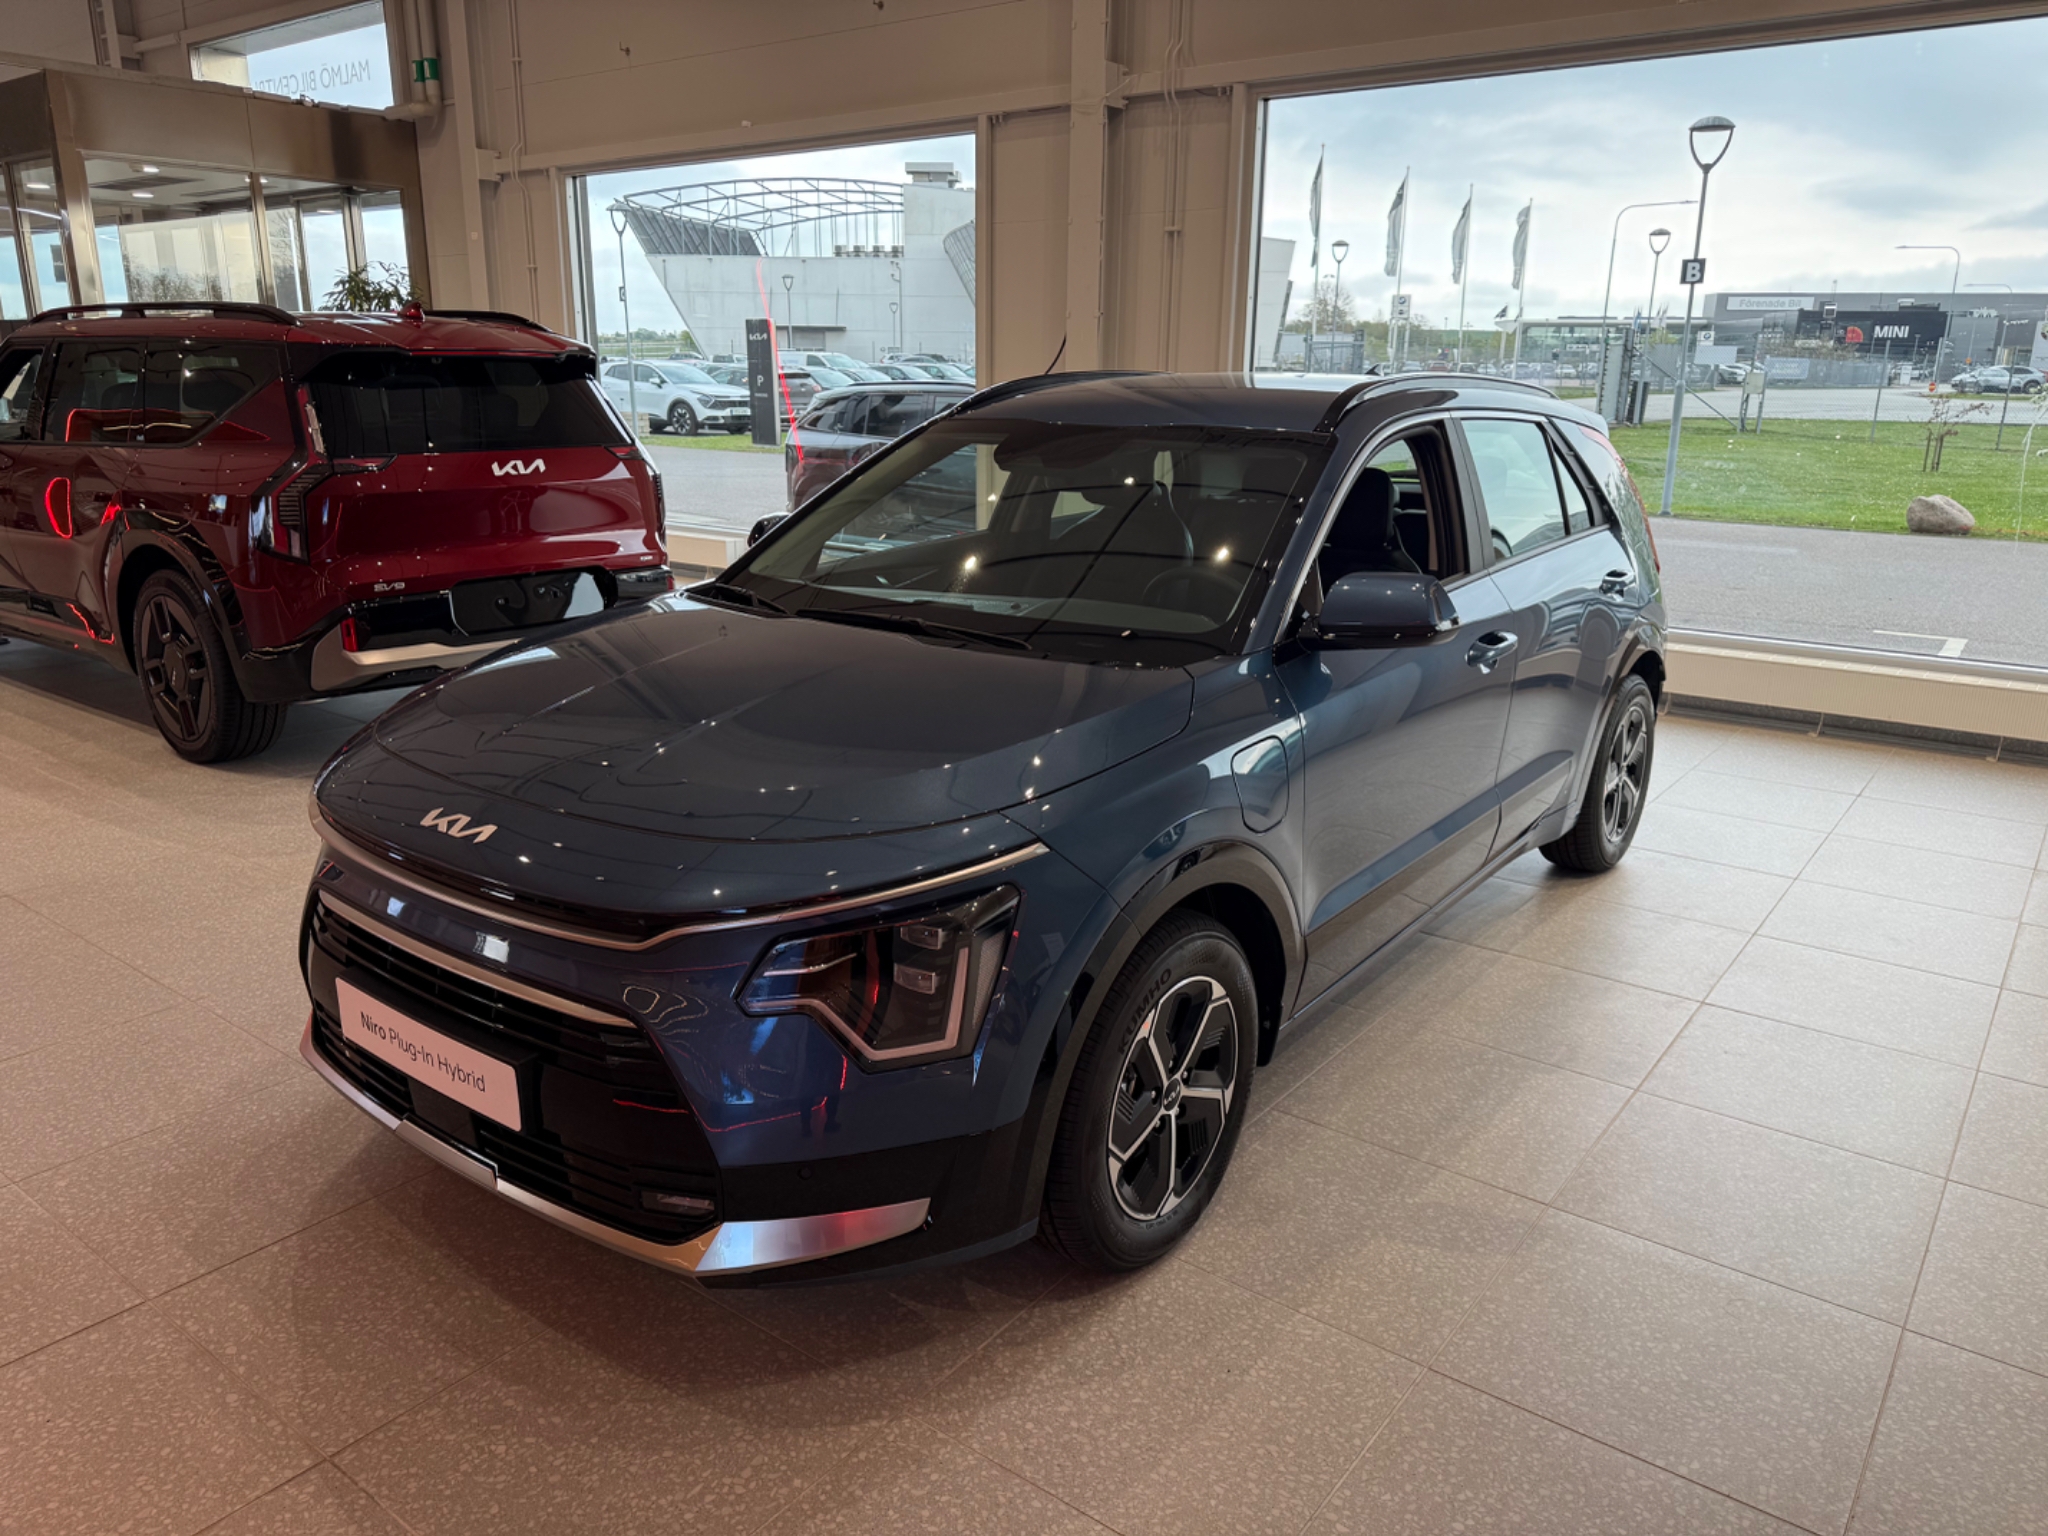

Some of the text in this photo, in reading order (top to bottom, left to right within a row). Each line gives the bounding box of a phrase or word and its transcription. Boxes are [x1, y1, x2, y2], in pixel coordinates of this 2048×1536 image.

[1685, 261, 1701, 282] B
[1873, 325, 1910, 338] MINI
[757, 375, 764, 386] P
[491, 458, 546, 477] KIA
[373, 581, 405, 592] EV9
[420, 807, 498, 843] KIA
[1117, 968, 1172, 1055] KUMHO
[360, 1011, 486, 1093] Niro Plug-In Hybrid
